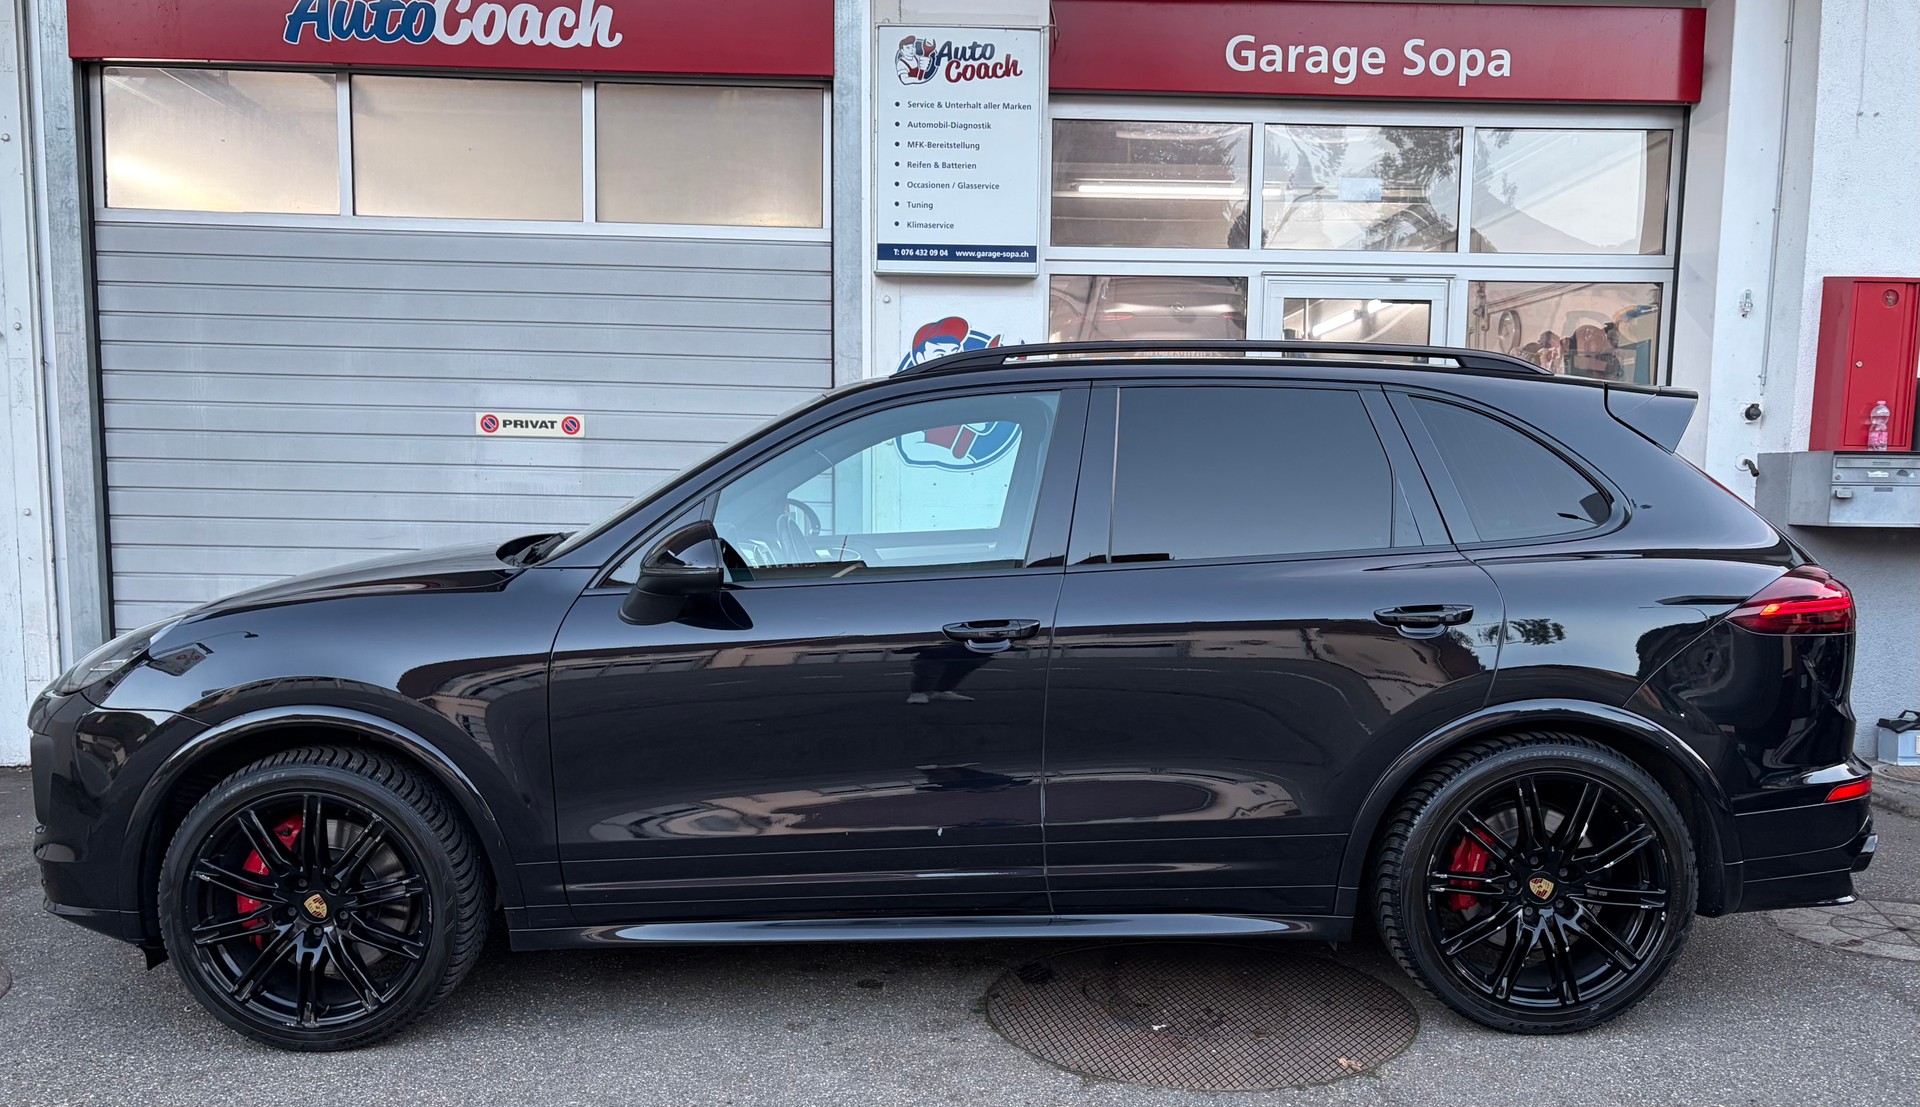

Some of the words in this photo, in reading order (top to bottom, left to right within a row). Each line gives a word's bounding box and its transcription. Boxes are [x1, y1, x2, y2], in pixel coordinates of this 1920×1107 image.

[283, 0, 623, 48] AutoCoach
[935, 40, 996, 66] Auto
[1225, 34, 1386, 85] Garage
[1403, 38, 1511, 87] Sopa
[945, 53, 1024, 84] Coach
[907, 100, 935, 109] Service
[936, 101, 943, 109] &
[944, 101, 982, 110] Unterhalt
[983, 101, 1001, 110] aller
[1002, 102, 1032, 111] Marken
[907, 120, 992, 131] Automobil-Diagnostik
[907, 140, 981, 151] MFK-Bereitstellung
[907, 160, 932, 169] Reifen
[933, 161, 940, 169] &
[941, 161, 977, 170] Batterien
[906, 180, 951, 190] Occasionen
[957, 181, 1000, 190] Glasservice
[906, 200, 934, 211] Tuning
[906, 220, 955, 230] Klimaservice
[893, 248, 900, 256] T:
[900, 248, 914, 257] 076
[915, 248, 929, 257] 432
[929, 249, 939, 257] 09
[939, 249, 949, 257] 04
[955, 250, 1030, 259] www.garage-sopa.ch
[502, 419, 558, 430] PRIVAT
